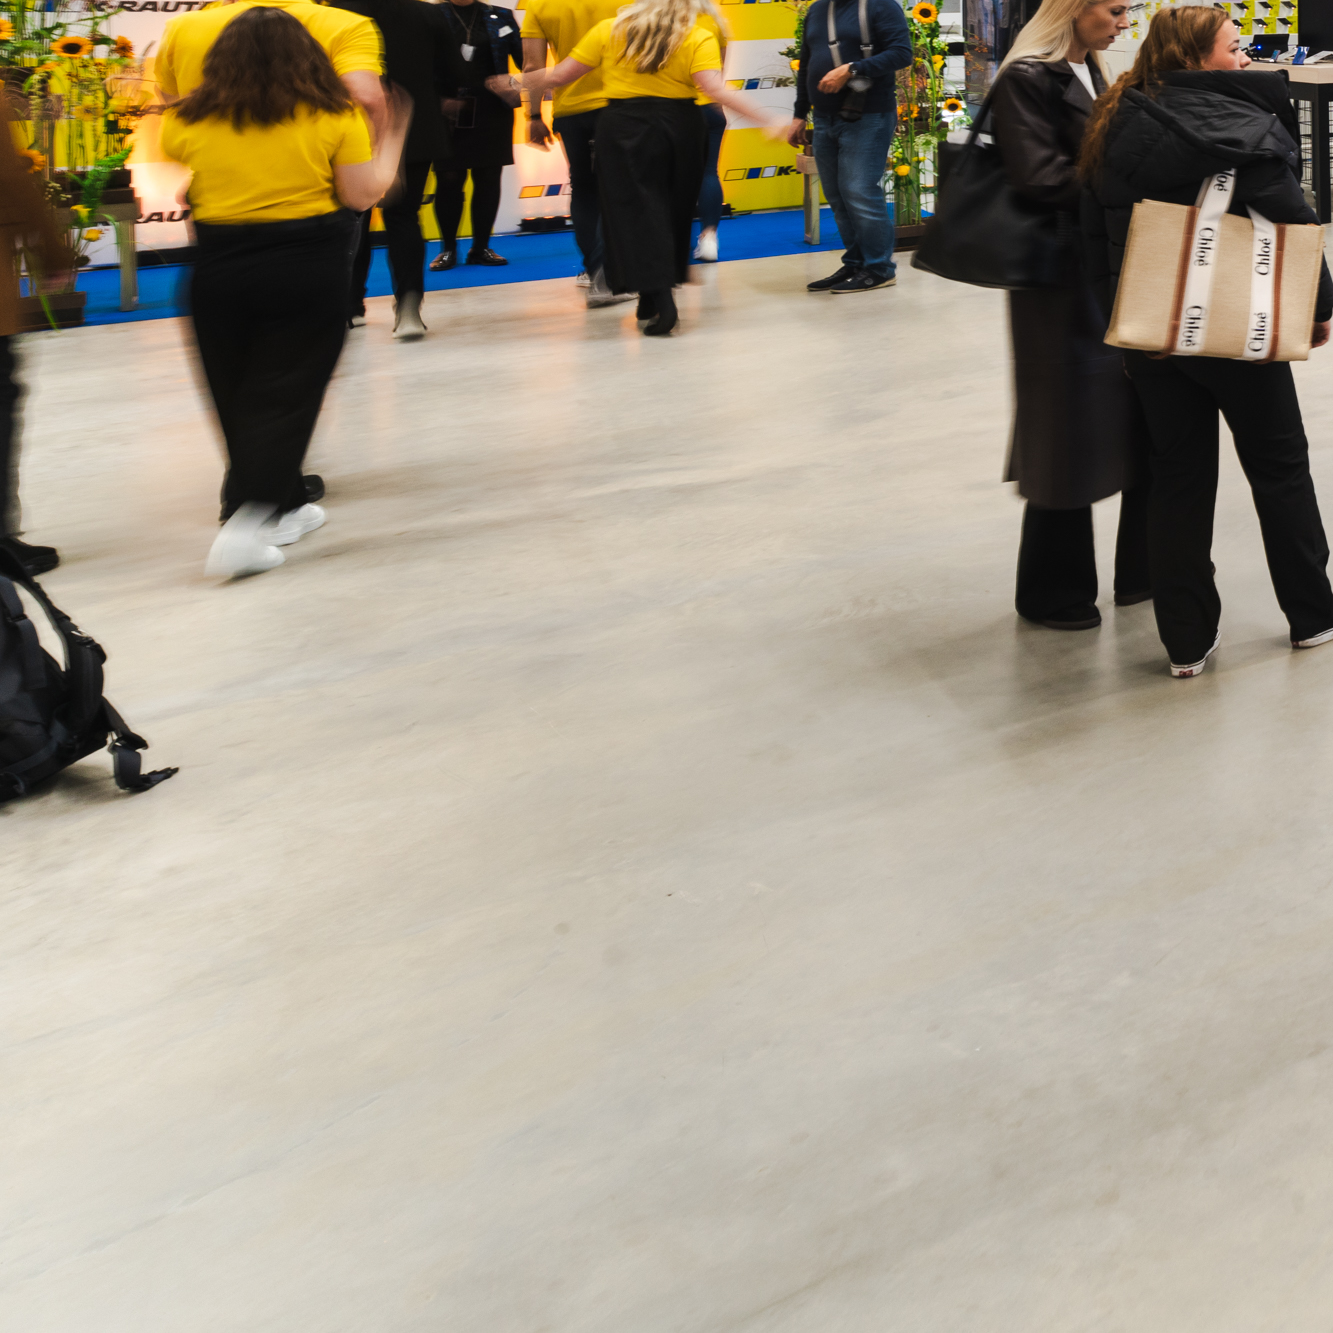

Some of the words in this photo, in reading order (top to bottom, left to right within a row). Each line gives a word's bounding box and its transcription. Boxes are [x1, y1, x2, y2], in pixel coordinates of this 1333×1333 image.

[1214, 168, 1236, 191] loé
[1194, 227, 1214, 266] Chloé
[1255, 238, 1271, 275] Chloé
[1181, 305, 1202, 347] Chloé
[1248, 312, 1267, 352] Chloé
